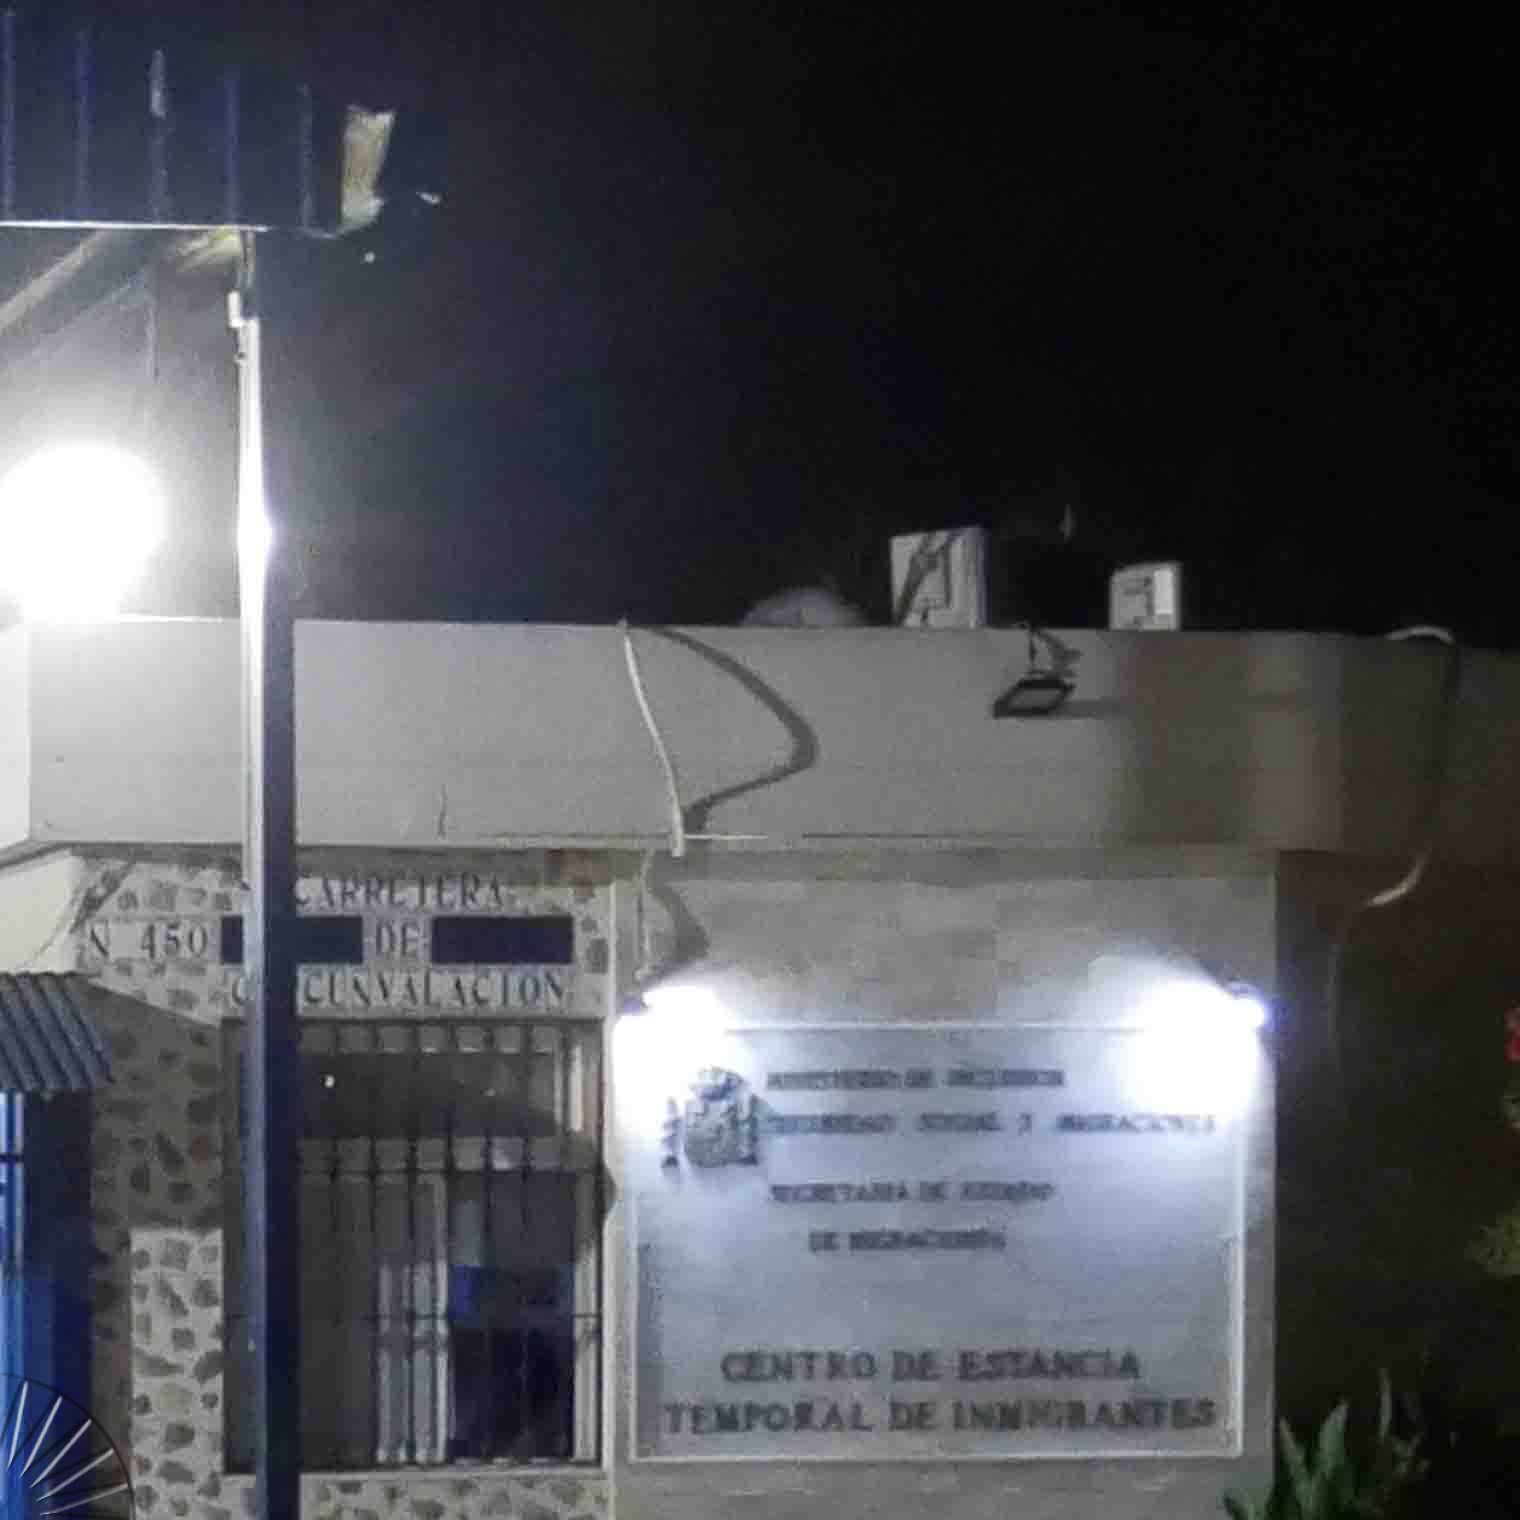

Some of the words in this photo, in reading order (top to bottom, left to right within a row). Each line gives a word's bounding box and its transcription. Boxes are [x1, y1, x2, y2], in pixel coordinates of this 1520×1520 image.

[294, 870, 505, 909] CARRETERA
[140, 921, 209, 958] 450
[375, 921, 420, 958] DE
[231, 969, 566, 1010] CCUNVALACION
[720, 1350, 876, 1382] CENTRO
[890, 1350, 940, 1382] DE
[959, 1350, 1142, 1381] ESTANCIA
[664, 1400, 873, 1434] TEMPORAL
[888, 1400, 938, 1432] DE
[951, 1398, 1218, 1432] INMIGRANTES
